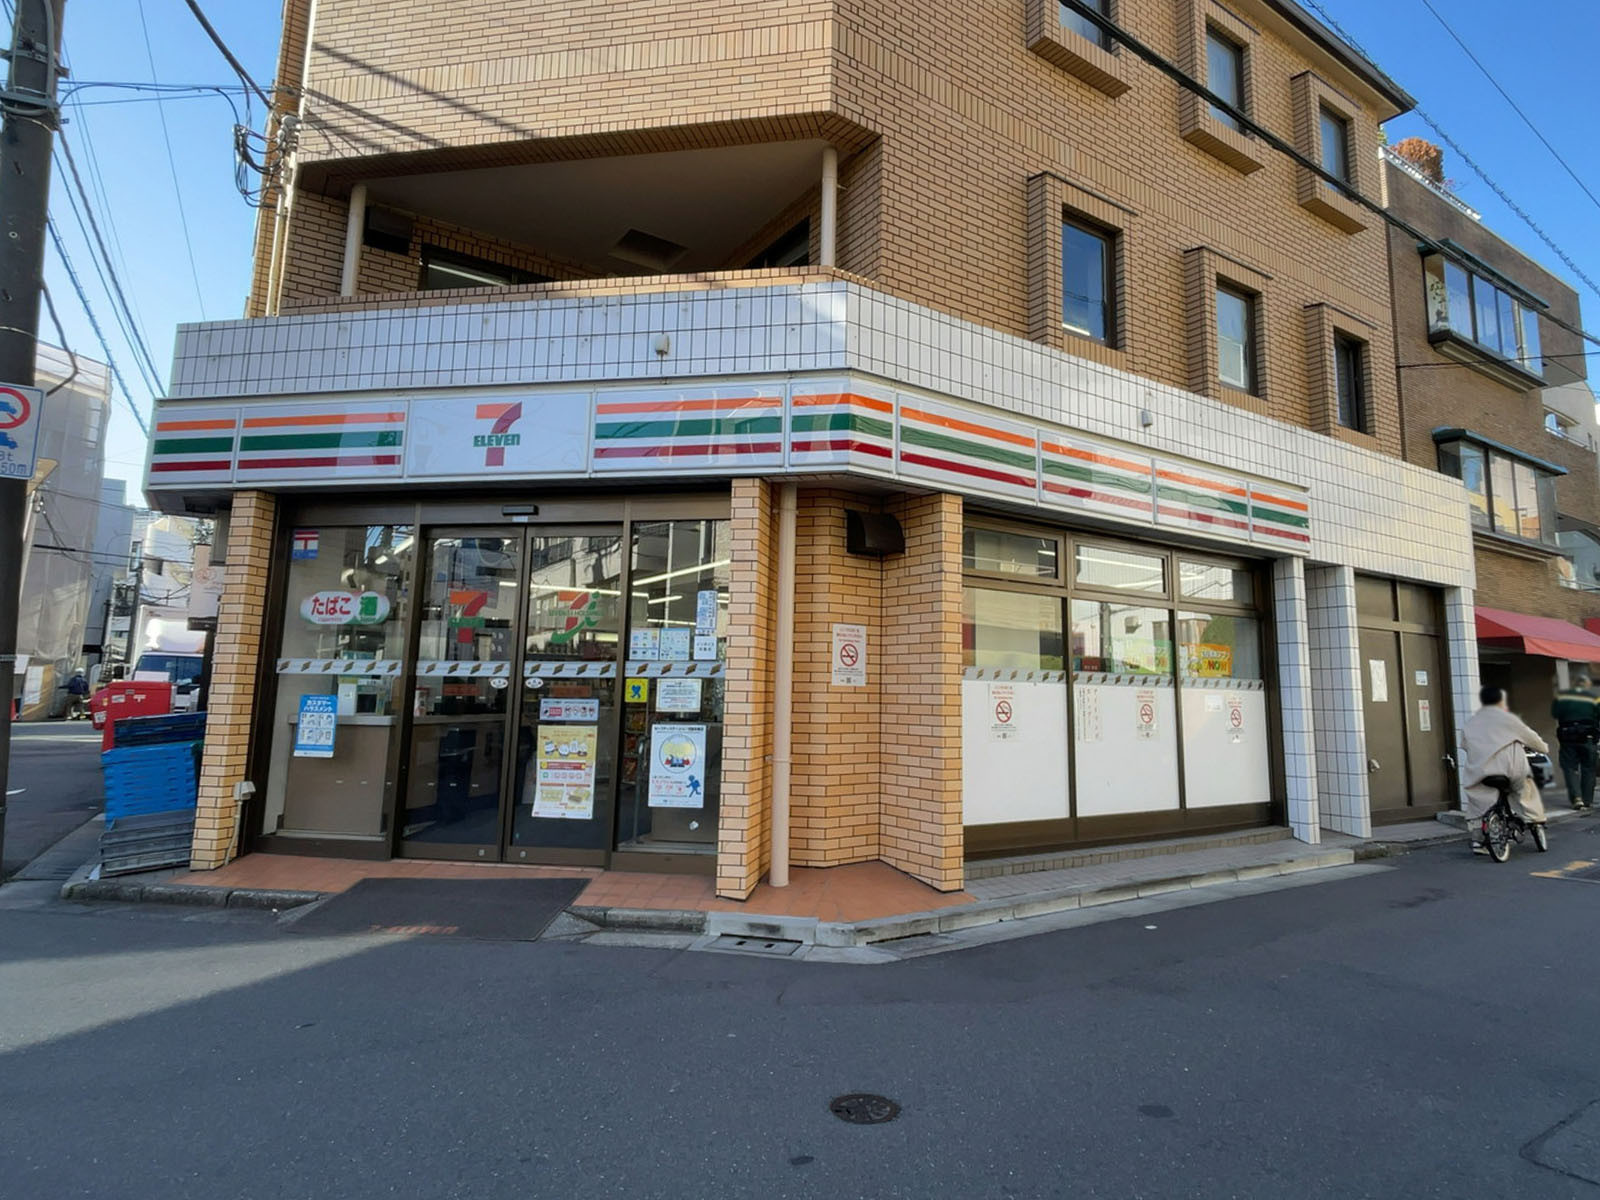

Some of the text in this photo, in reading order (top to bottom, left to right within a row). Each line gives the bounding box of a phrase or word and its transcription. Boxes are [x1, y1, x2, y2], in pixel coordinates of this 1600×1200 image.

[475, 400, 523, 467] 7
[311, 596, 352, 616] たばこ
